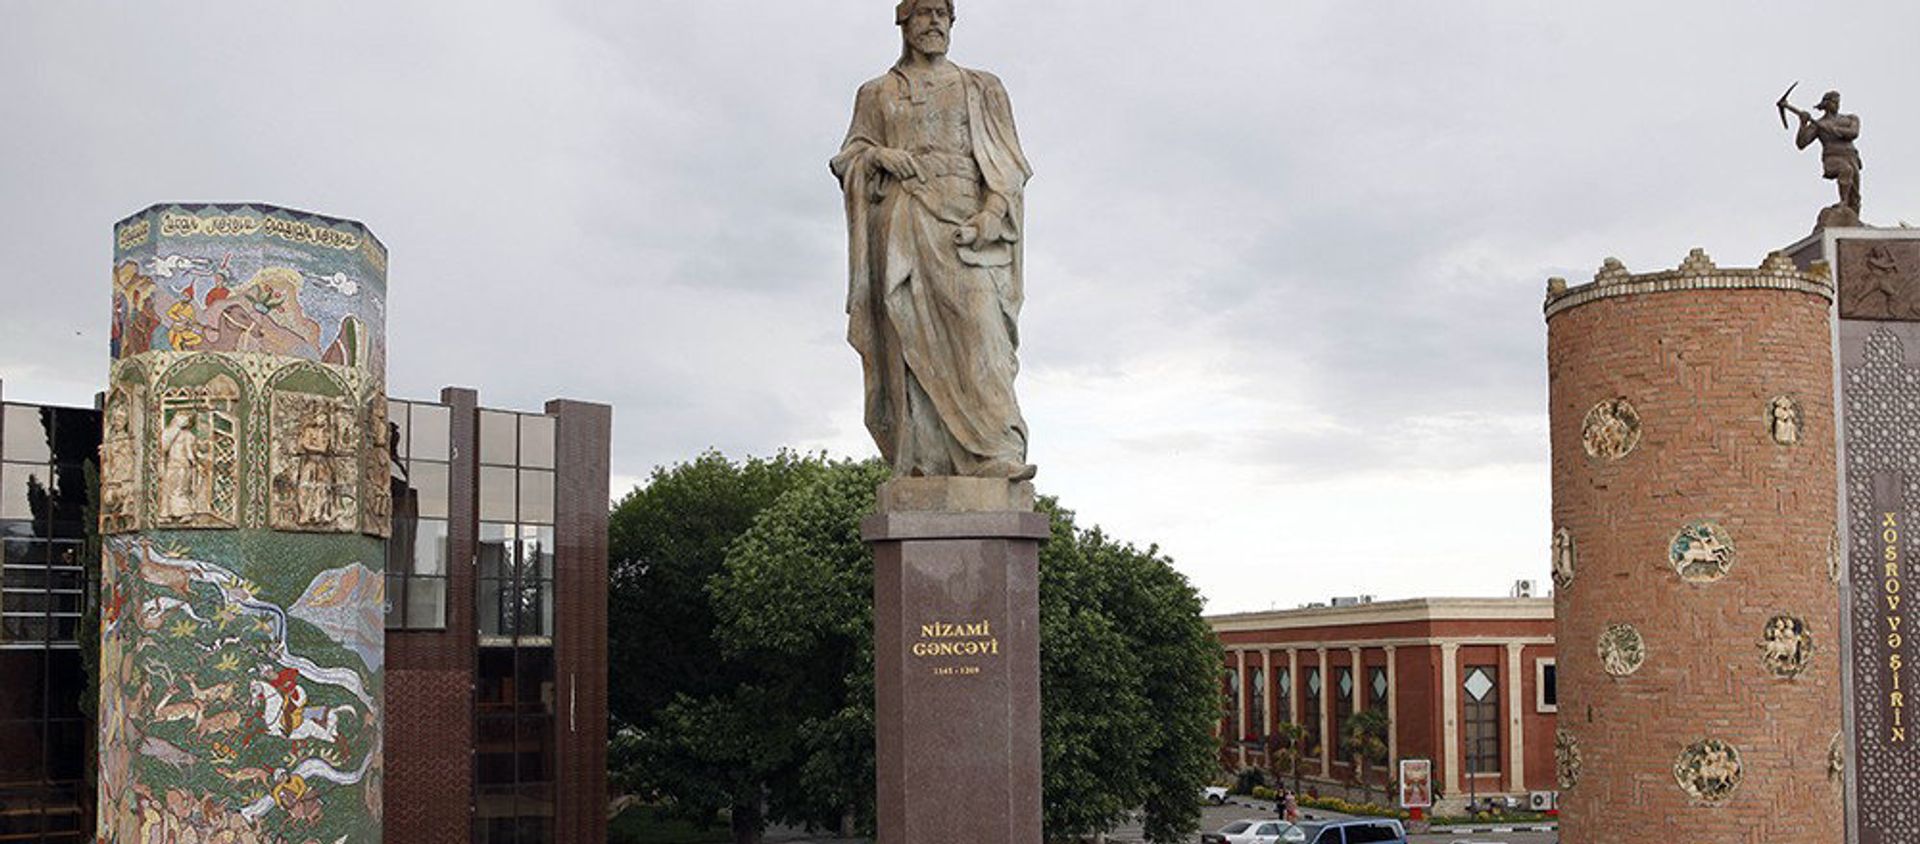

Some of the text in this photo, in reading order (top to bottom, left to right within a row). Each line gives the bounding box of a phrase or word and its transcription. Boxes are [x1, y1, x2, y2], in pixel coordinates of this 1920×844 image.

[920, 619, 990, 637] NİZAMİ
[1882, 512, 1905, 742] XOSROV VƏ ŞİRİN
[913, 637, 999, 656] GƏNCƏVİ
